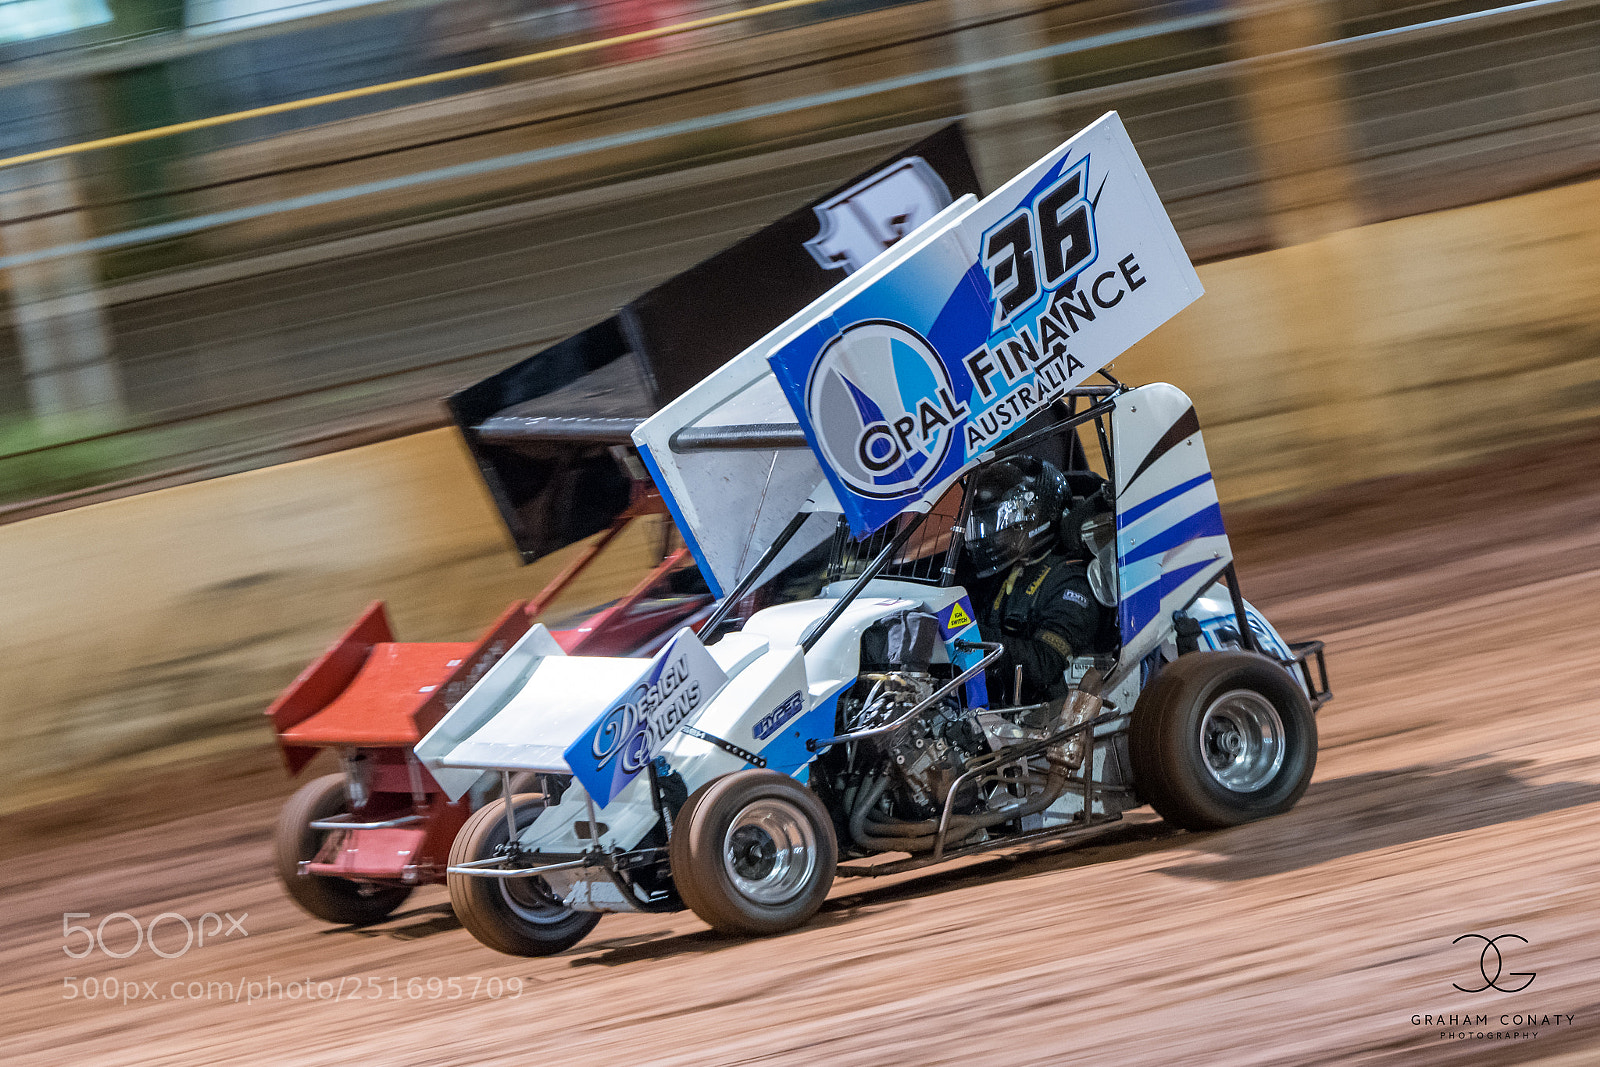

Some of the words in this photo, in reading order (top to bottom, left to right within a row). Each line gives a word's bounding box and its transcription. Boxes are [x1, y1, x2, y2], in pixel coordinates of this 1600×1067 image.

[981, 156, 1098, 332] 36
[858, 387, 968, 472] OPAL
[966, 252, 1147, 399] FINANCE
[966, 353, 1085, 450] AUSTRALIA
[592, 653, 688, 771] DESIGN
[755, 690, 805, 739] HYPER
